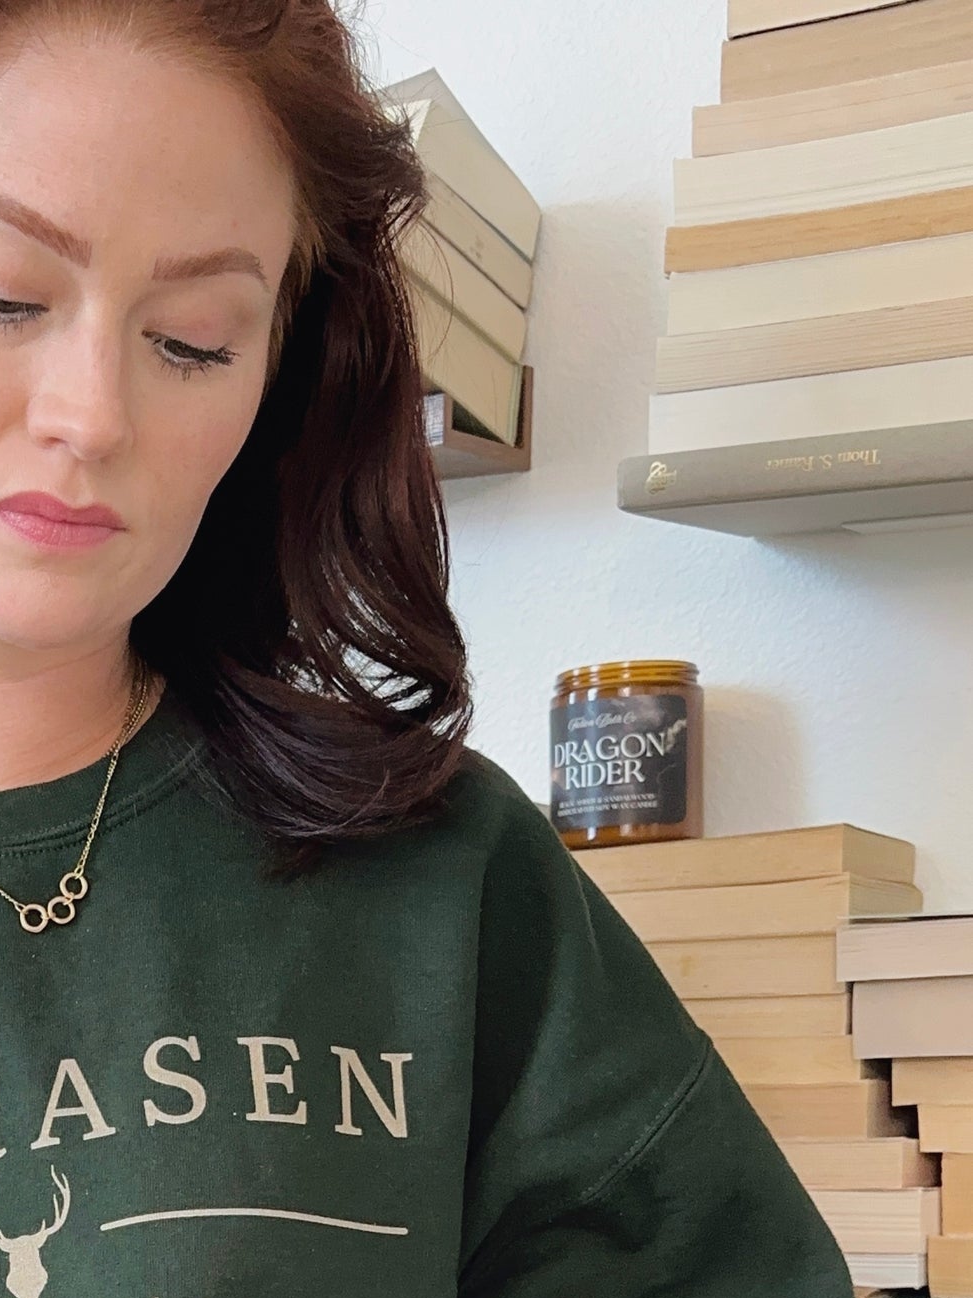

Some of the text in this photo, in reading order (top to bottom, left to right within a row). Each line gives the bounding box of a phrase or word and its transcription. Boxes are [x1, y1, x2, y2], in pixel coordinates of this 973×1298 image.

[819, 453, 833, 470] S.
[838, 449, 880, 464] Thom
[554, 732, 667, 768] DRAGON
[565, 760, 644, 790] RIDER
